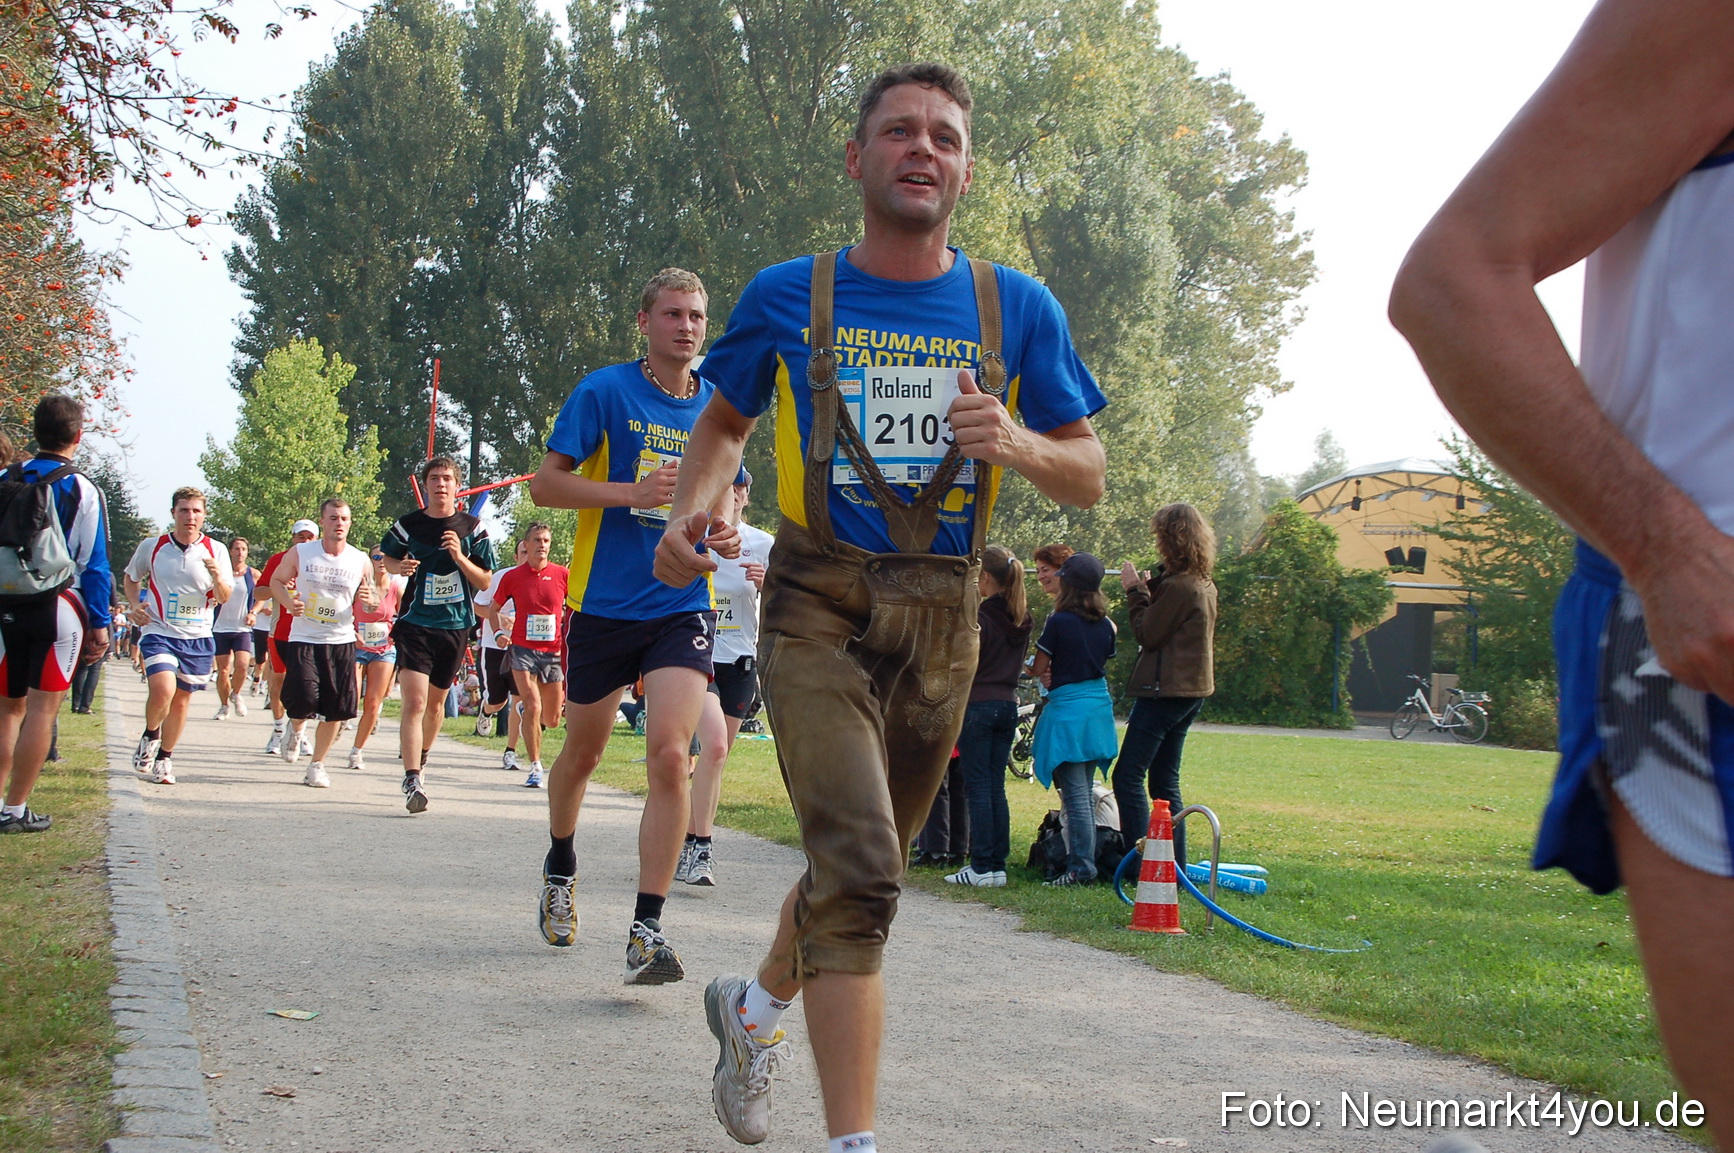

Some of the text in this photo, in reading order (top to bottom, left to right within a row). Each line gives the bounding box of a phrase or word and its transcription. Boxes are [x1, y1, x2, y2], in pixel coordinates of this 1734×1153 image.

[836, 326, 982, 362] NEUMARKT
[872, 377, 932, 399] Roland
[628, 419, 689, 442] 10. NEUMA
[874, 413, 956, 446] 2103
[644, 435, 686, 453] STADTL
[323, 575, 337, 583] NYC
[435, 583, 458, 595] 2297
[179, 605, 202, 615] 3851
[318, 606, 336, 617] 999
[367, 631, 386, 639] 3869
